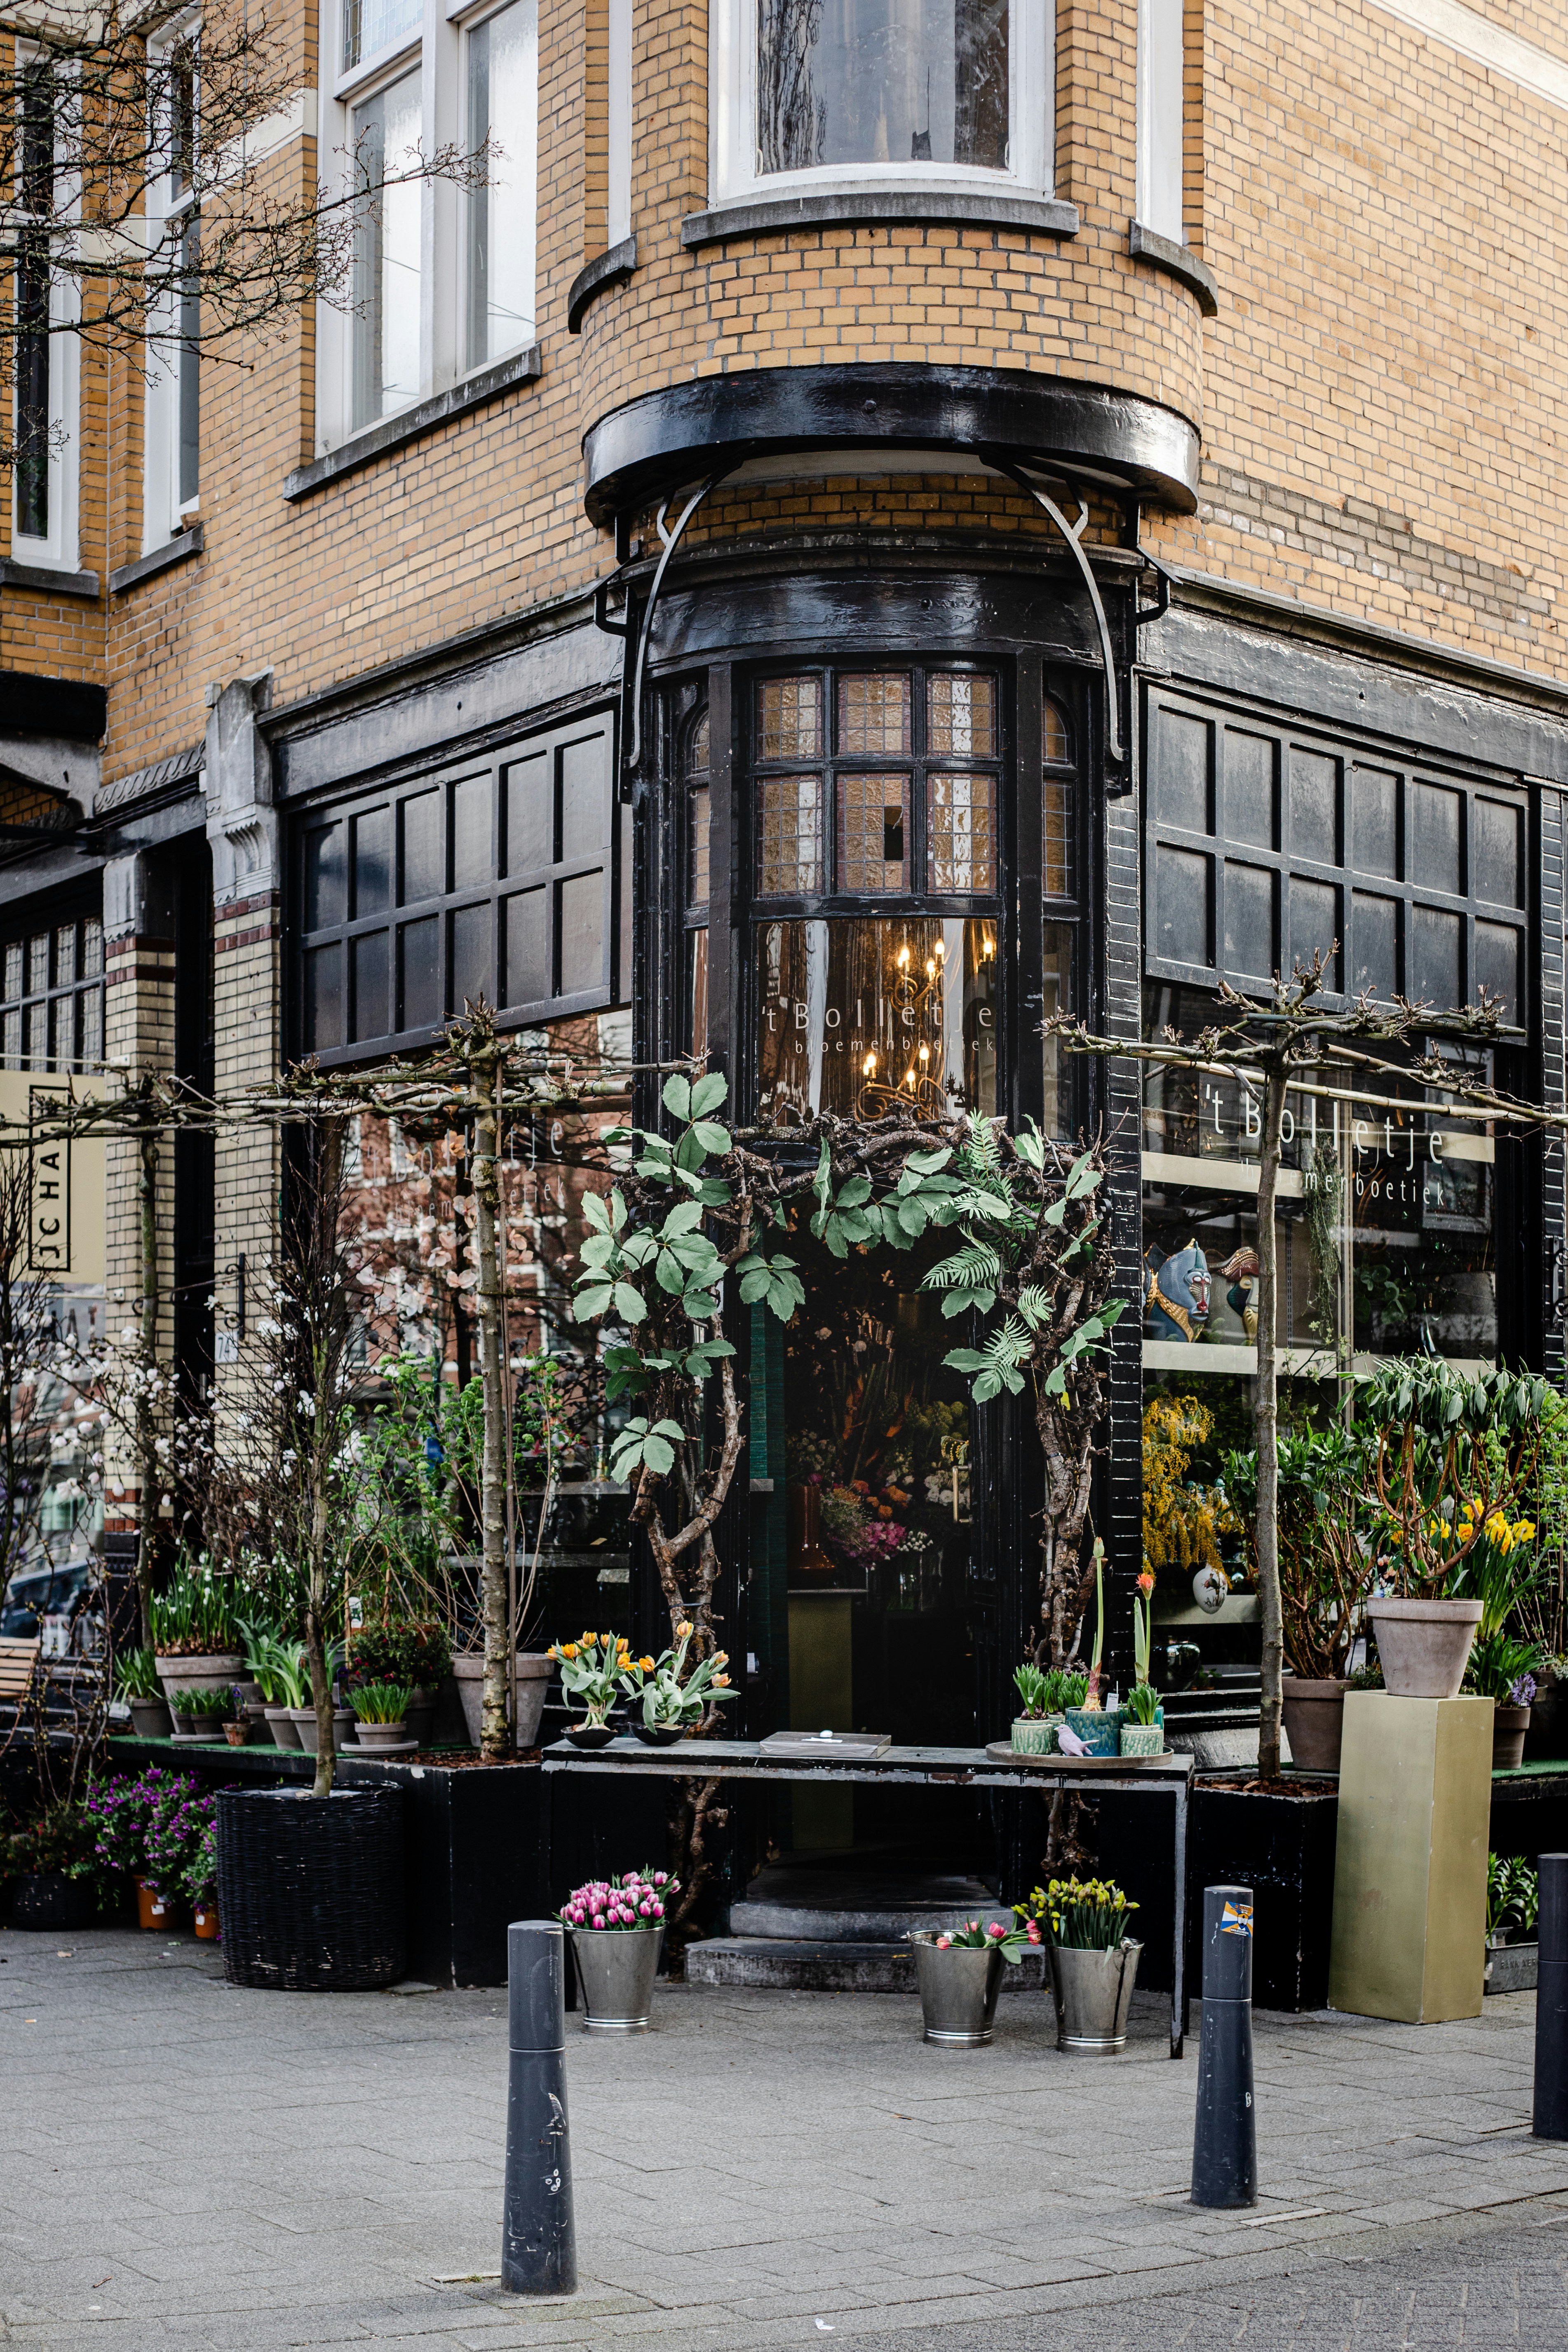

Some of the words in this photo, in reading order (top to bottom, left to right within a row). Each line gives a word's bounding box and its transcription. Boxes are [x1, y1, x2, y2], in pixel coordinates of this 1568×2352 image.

[762, 1006, 776, 1032] 't
[795, 998, 991, 1033] Bolletje
[795, 1036, 993, 1054] bloemenboetiek
[396, 1113, 563, 1183] Bolltje
[1206, 1084, 1224, 1134] 't
[1246, 1090, 1443, 1172] Bolletje
[1245, 1157, 1444, 1206] boemenboetiek
